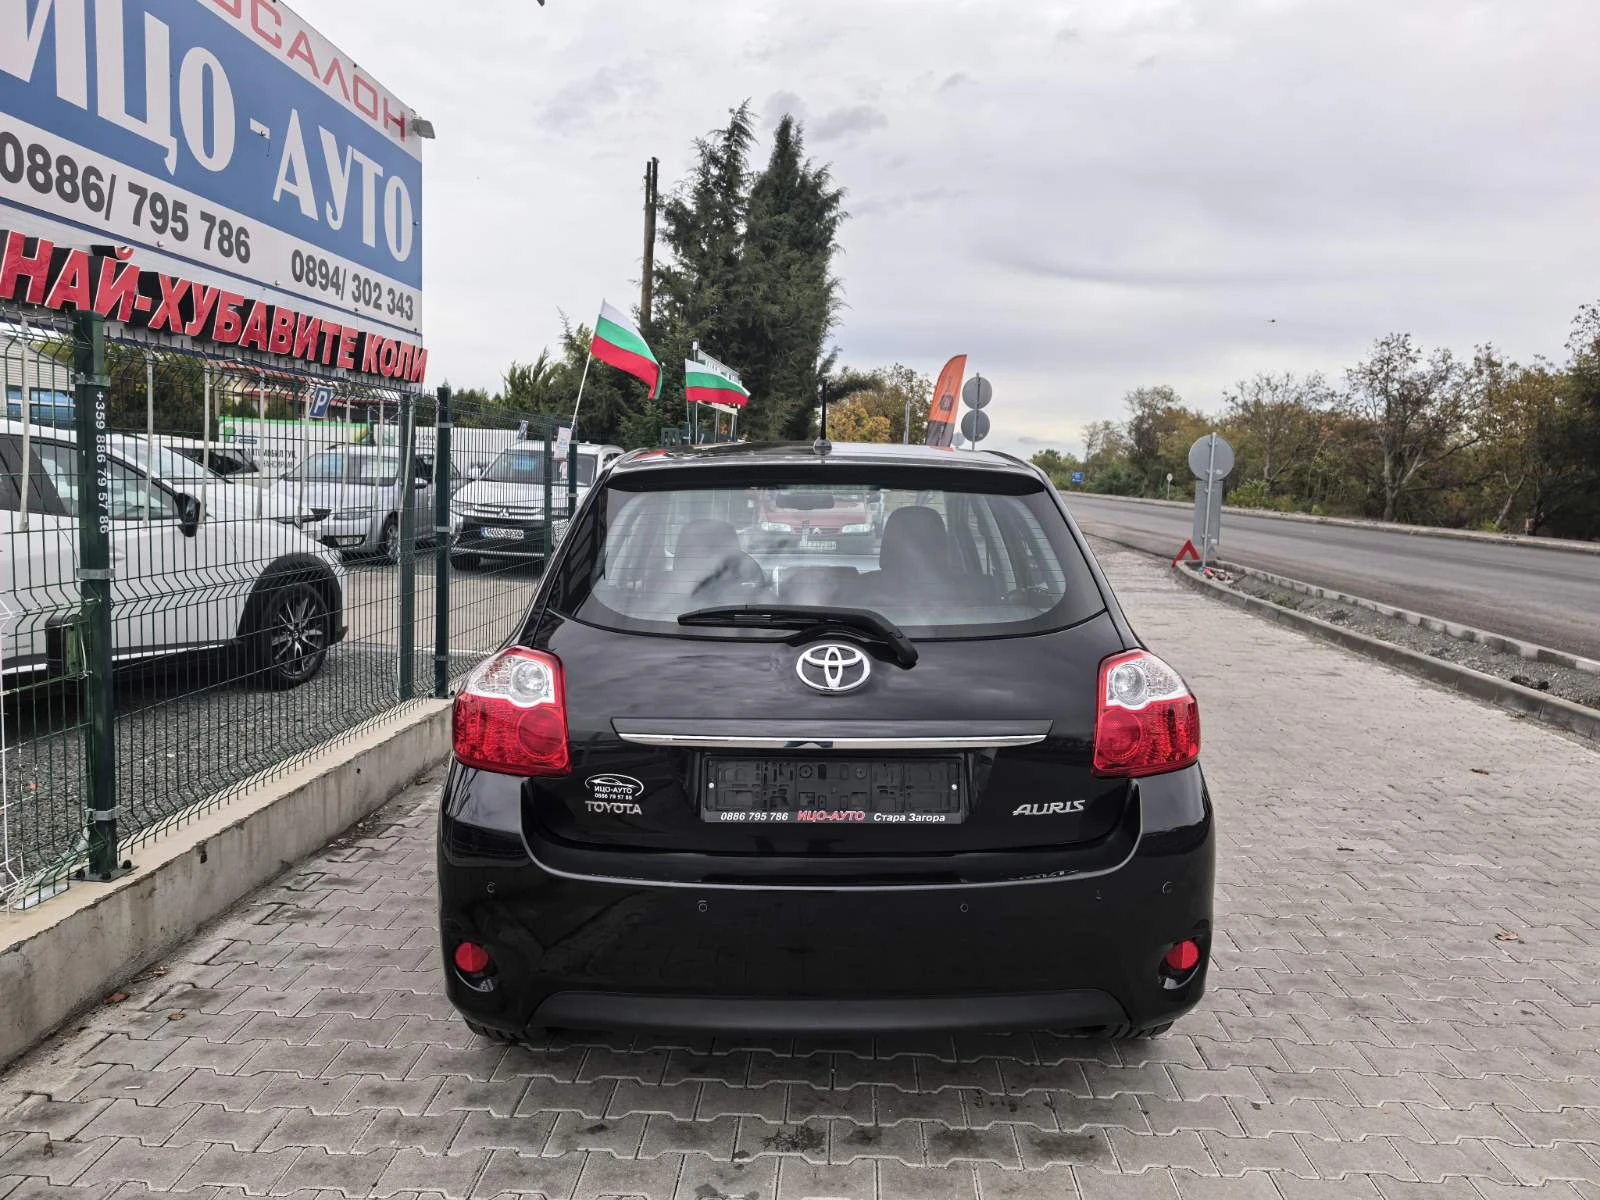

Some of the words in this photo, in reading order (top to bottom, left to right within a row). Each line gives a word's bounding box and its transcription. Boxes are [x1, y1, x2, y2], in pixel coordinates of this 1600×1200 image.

[0, 131, 117, 221] 0886/
[127, 181, 190, 242] 795
[199, 210, 251, 264] 786
[291, 249, 347, 301] 0894/
[351, 273, 383, 310] 302
[387, 288, 414, 321] 343
[0, 229, 359, 370] НАЙ-ХУБАВИТЕ
[361, 332, 429, 385] КОЛИ
[95, 391, 106, 429] +359
[313, 389, 328, 414] P
[96, 434, 107, 463] 886
[97, 467, 108, 487] 79
[98, 491, 109, 511] 57
[99, 515, 110, 534] 86
[594, 786, 633, 794] ИЦО-АУТО
[584, 800, 643, 815] TOYOTA
[720, 811, 748, 821] 0886
[748, 811, 767, 821] 795
[769, 811, 789, 821] 786
[797, 810, 866, 823] ИЦО-АУТО
[873, 812, 906, 823] Стара
[908, 812, 946, 823] Загора
[1012, 799, 1086, 816] AURIS
